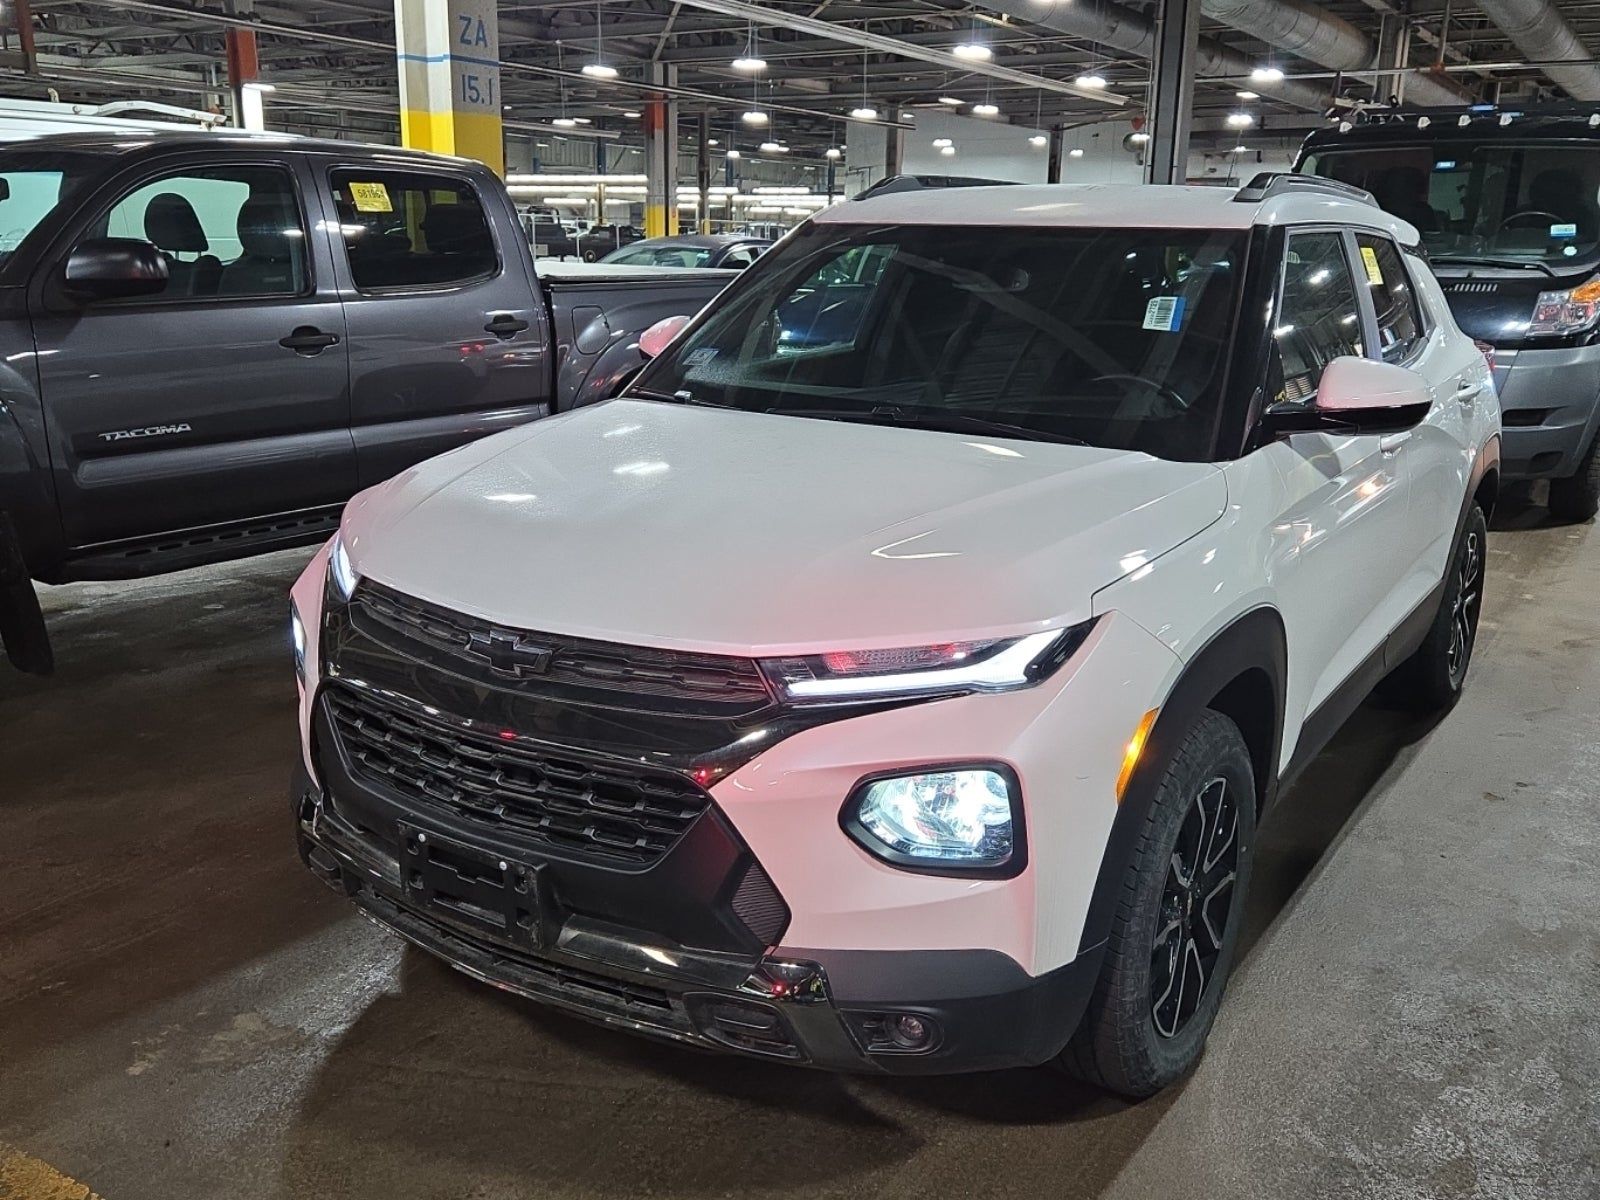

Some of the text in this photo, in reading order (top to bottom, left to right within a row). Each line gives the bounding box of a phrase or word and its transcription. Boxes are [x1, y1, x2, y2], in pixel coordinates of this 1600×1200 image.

[459, 15, 487, 48] ZA
[462, 74, 492, 105] 15.1
[98, 423, 192, 440] TACOMA
